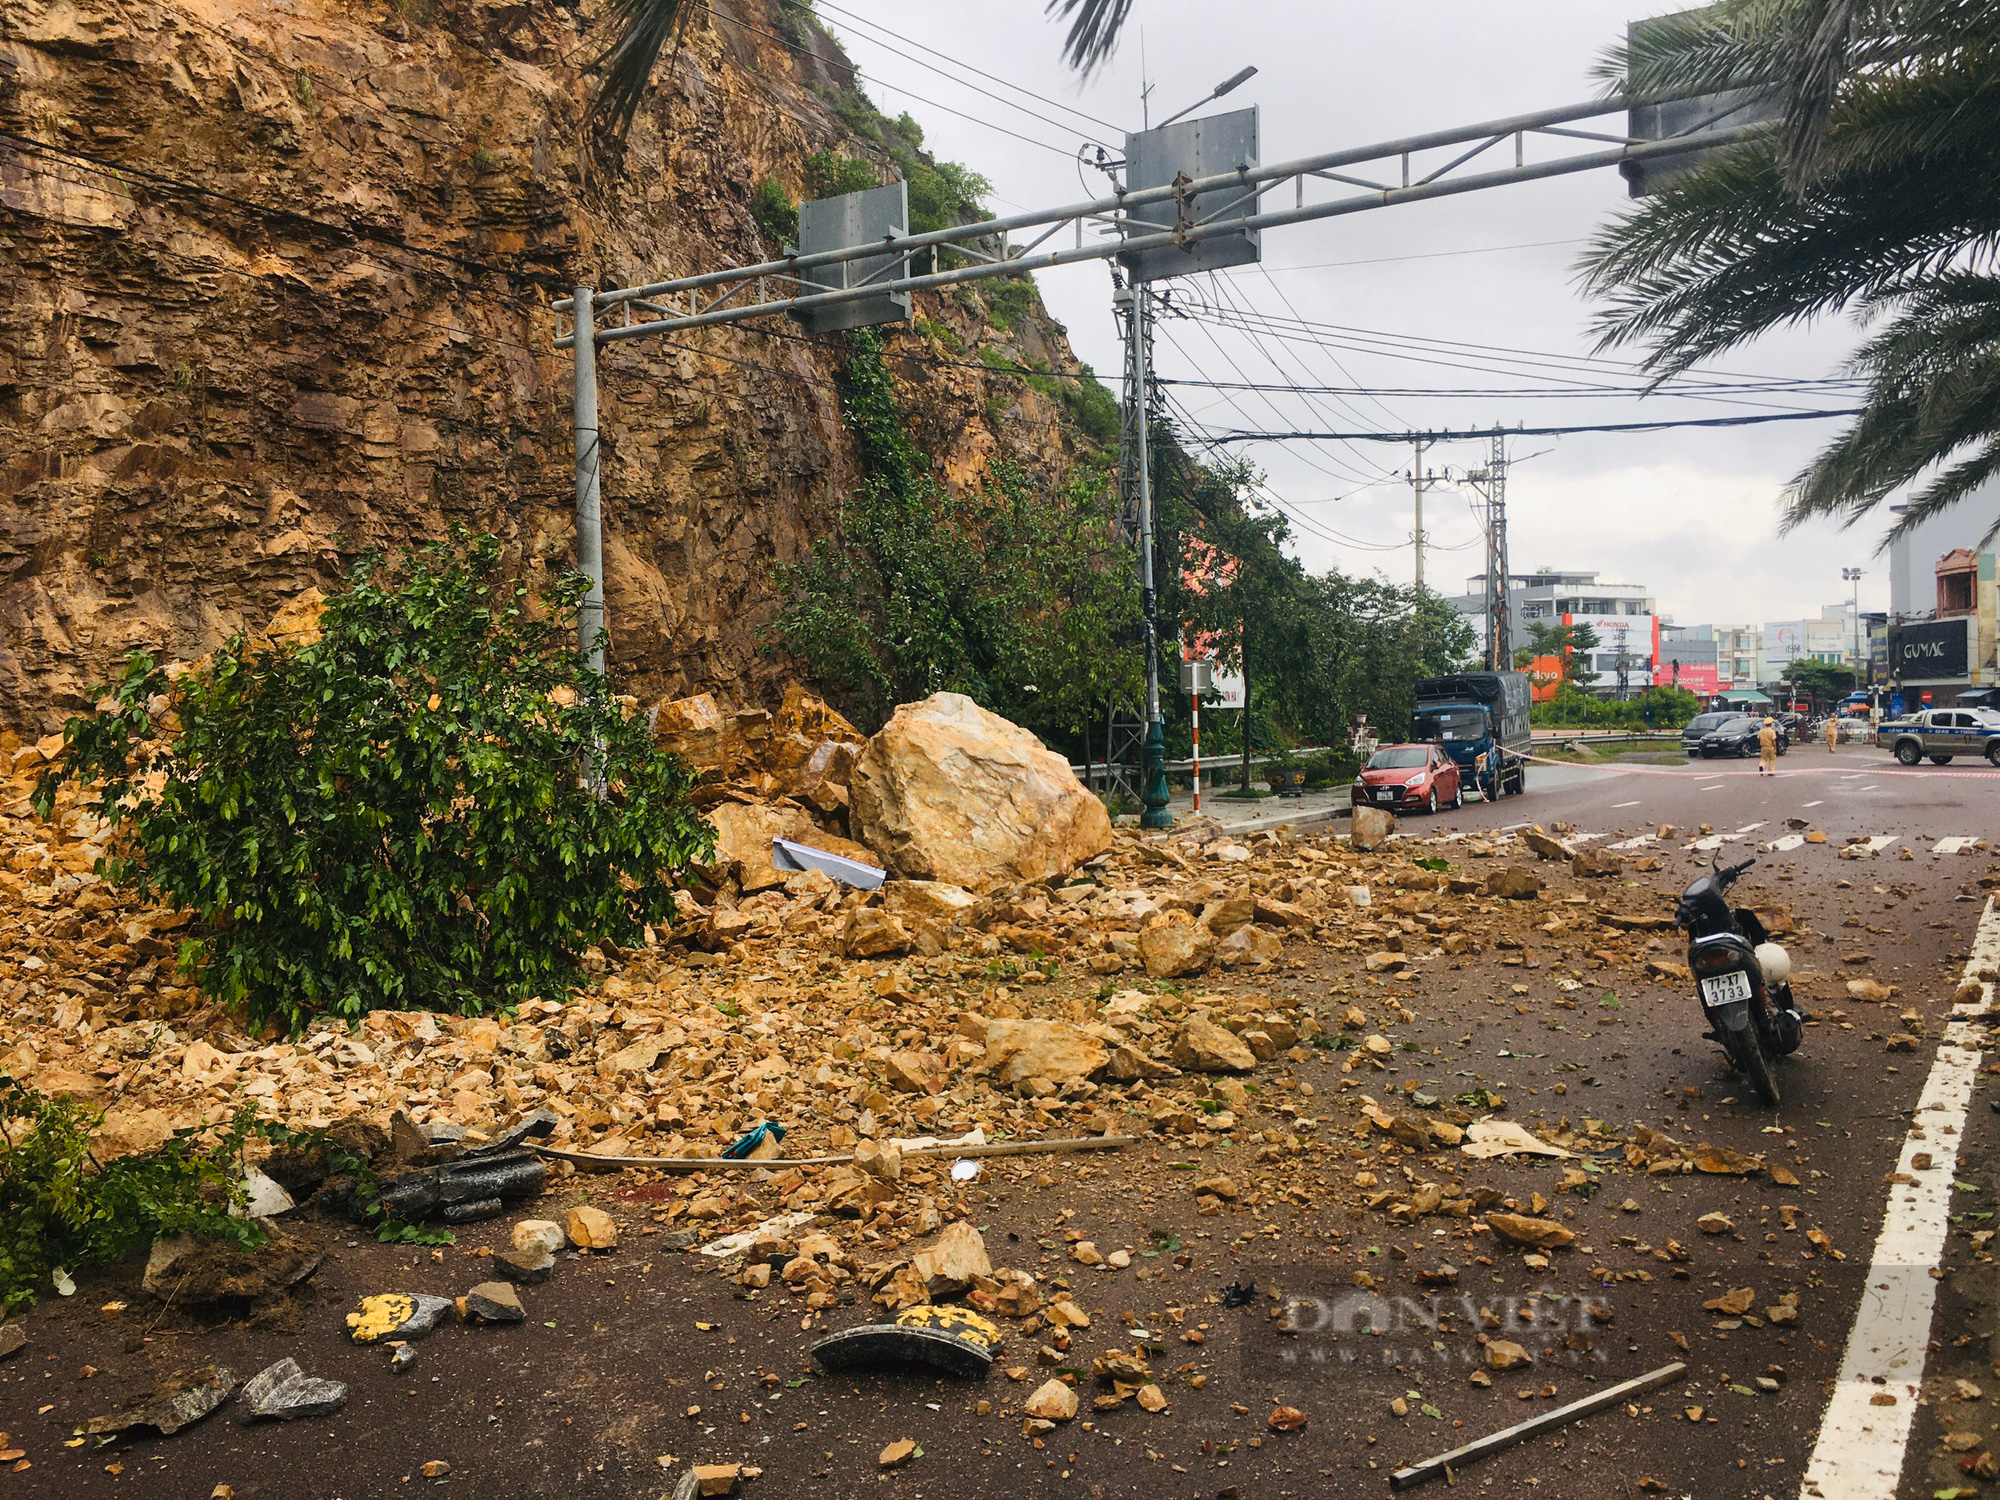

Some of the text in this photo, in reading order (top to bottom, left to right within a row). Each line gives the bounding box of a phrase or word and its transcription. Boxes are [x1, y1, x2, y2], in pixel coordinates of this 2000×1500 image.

[1904, 641, 1946, 659] GUMAC
[1708, 974, 1739, 991] 77-X7
[1711, 986, 1744, 1002] 3733
